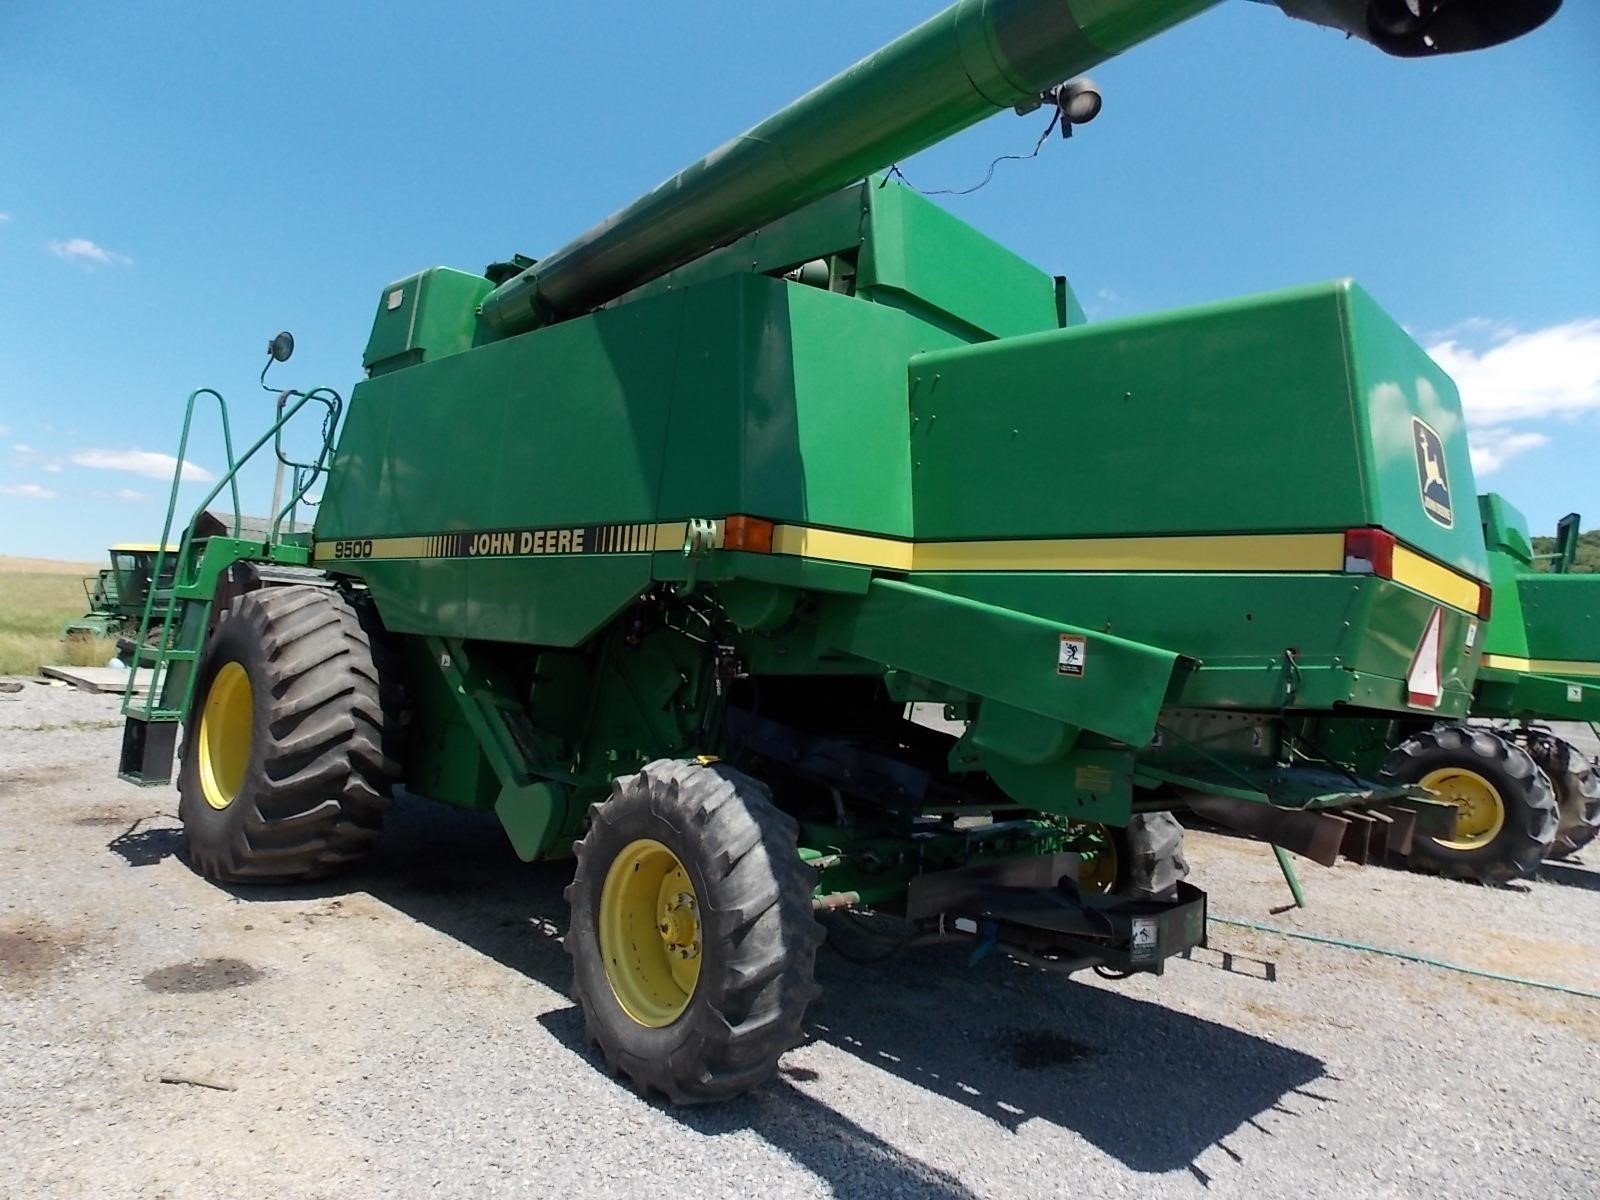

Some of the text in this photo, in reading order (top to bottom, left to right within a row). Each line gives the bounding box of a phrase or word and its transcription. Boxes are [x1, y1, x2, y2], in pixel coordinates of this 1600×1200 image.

[335, 540, 372, 558] 9500
[469, 529, 584, 555] JOHN DEERE
